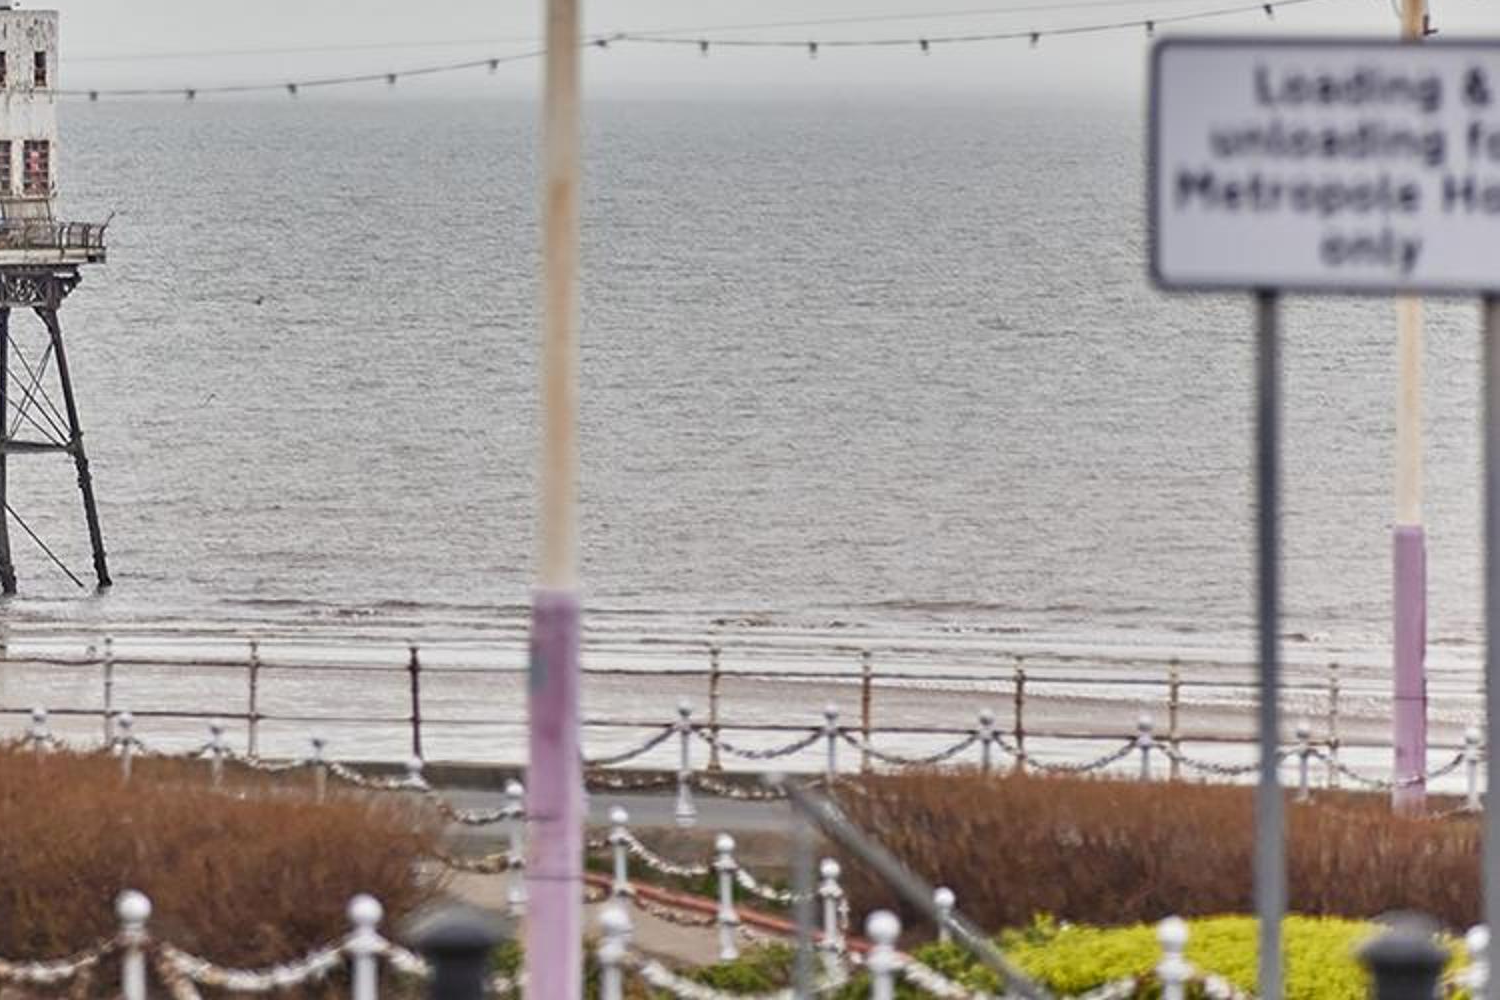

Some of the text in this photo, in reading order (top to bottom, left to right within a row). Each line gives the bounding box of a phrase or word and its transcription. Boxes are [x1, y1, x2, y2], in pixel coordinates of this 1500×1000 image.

[1253, 64, 1491, 114] Loading &
[1209, 118, 1446, 168] unloading
[1174, 169, 1421, 217] Metropole
[1317, 224, 1423, 276] only
